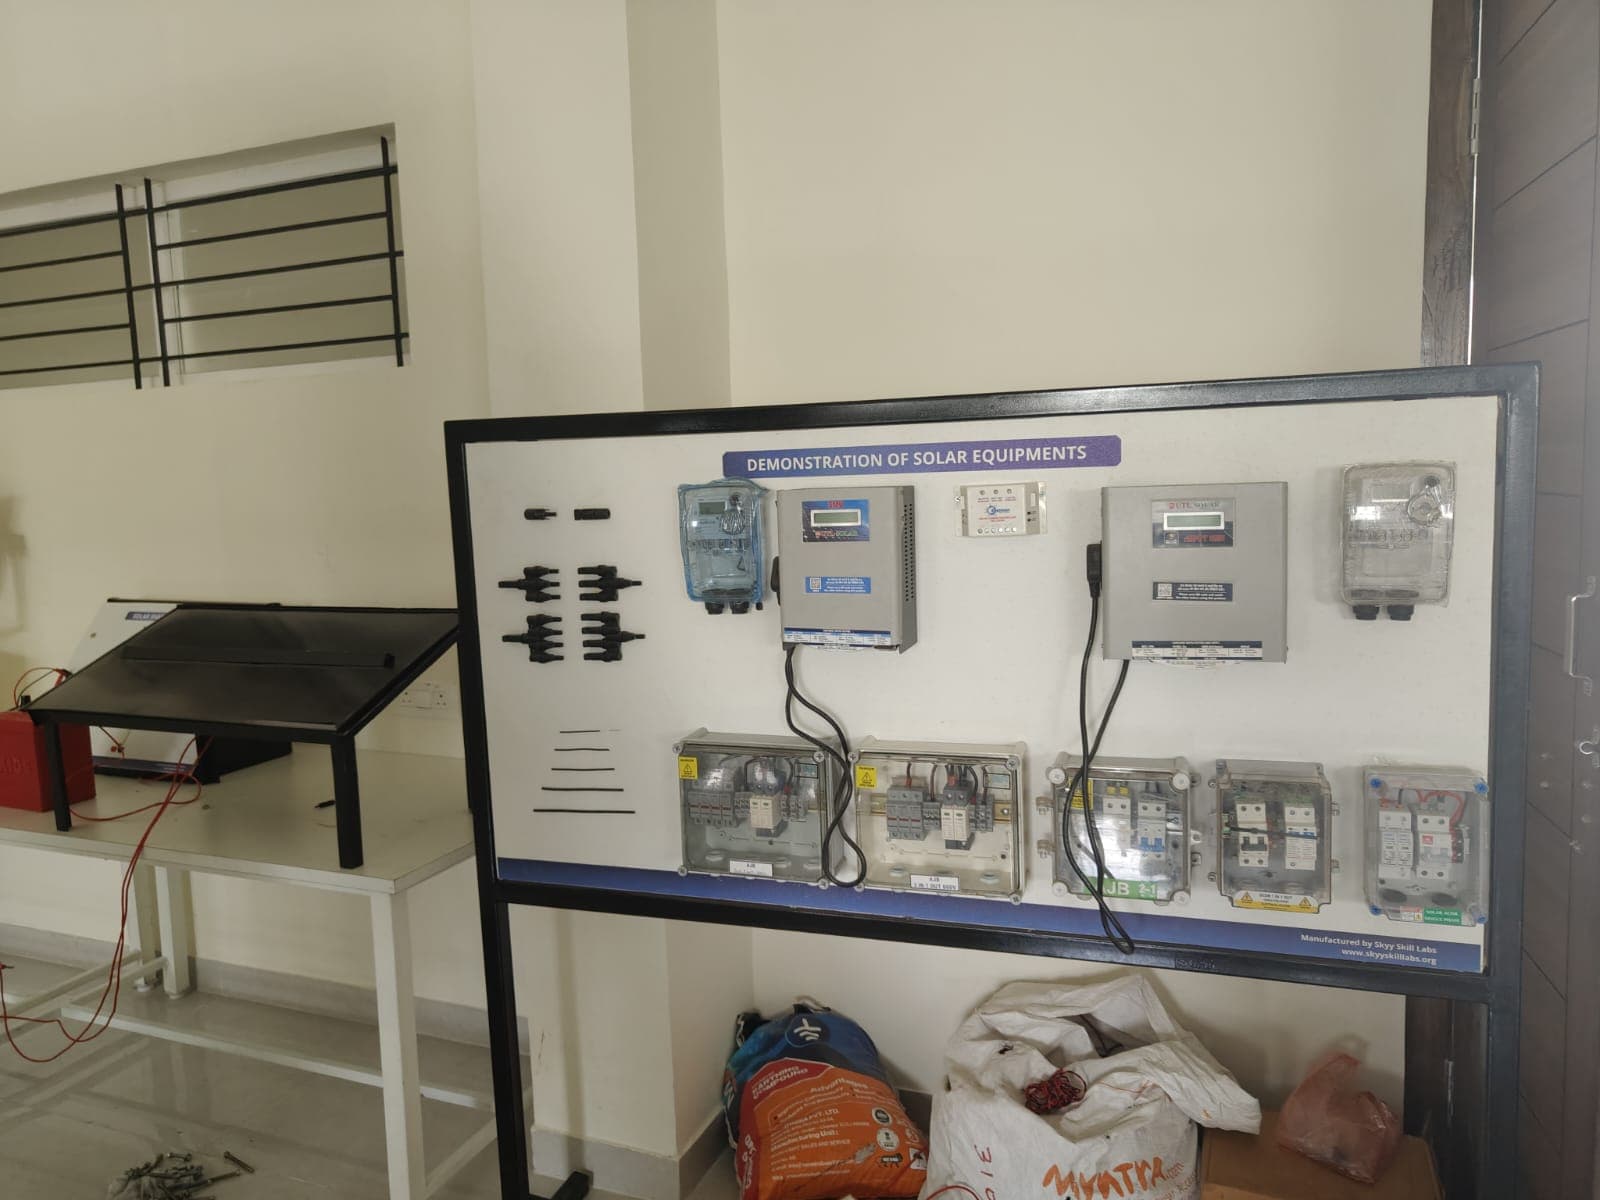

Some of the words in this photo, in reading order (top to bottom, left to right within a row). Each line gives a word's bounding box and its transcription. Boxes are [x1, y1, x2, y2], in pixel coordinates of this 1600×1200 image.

[747, 453, 882, 472] DEMONSTRATION
[887, 452, 909, 467] OF
[913, 450, 968, 466] SOLAR
[972, 445, 1087, 465] EQUIPMENTS
[1300, 933, 1360, 947] Manufactured
[1361, 939, 1373, 949] by
[1374, 941, 1394, 951] Skyy
[1396, 943, 1415, 952] Skill
[1416, 945, 1438, 954] Labs
[1341, 948, 1438, 966] www.skyyskilllabs.org
